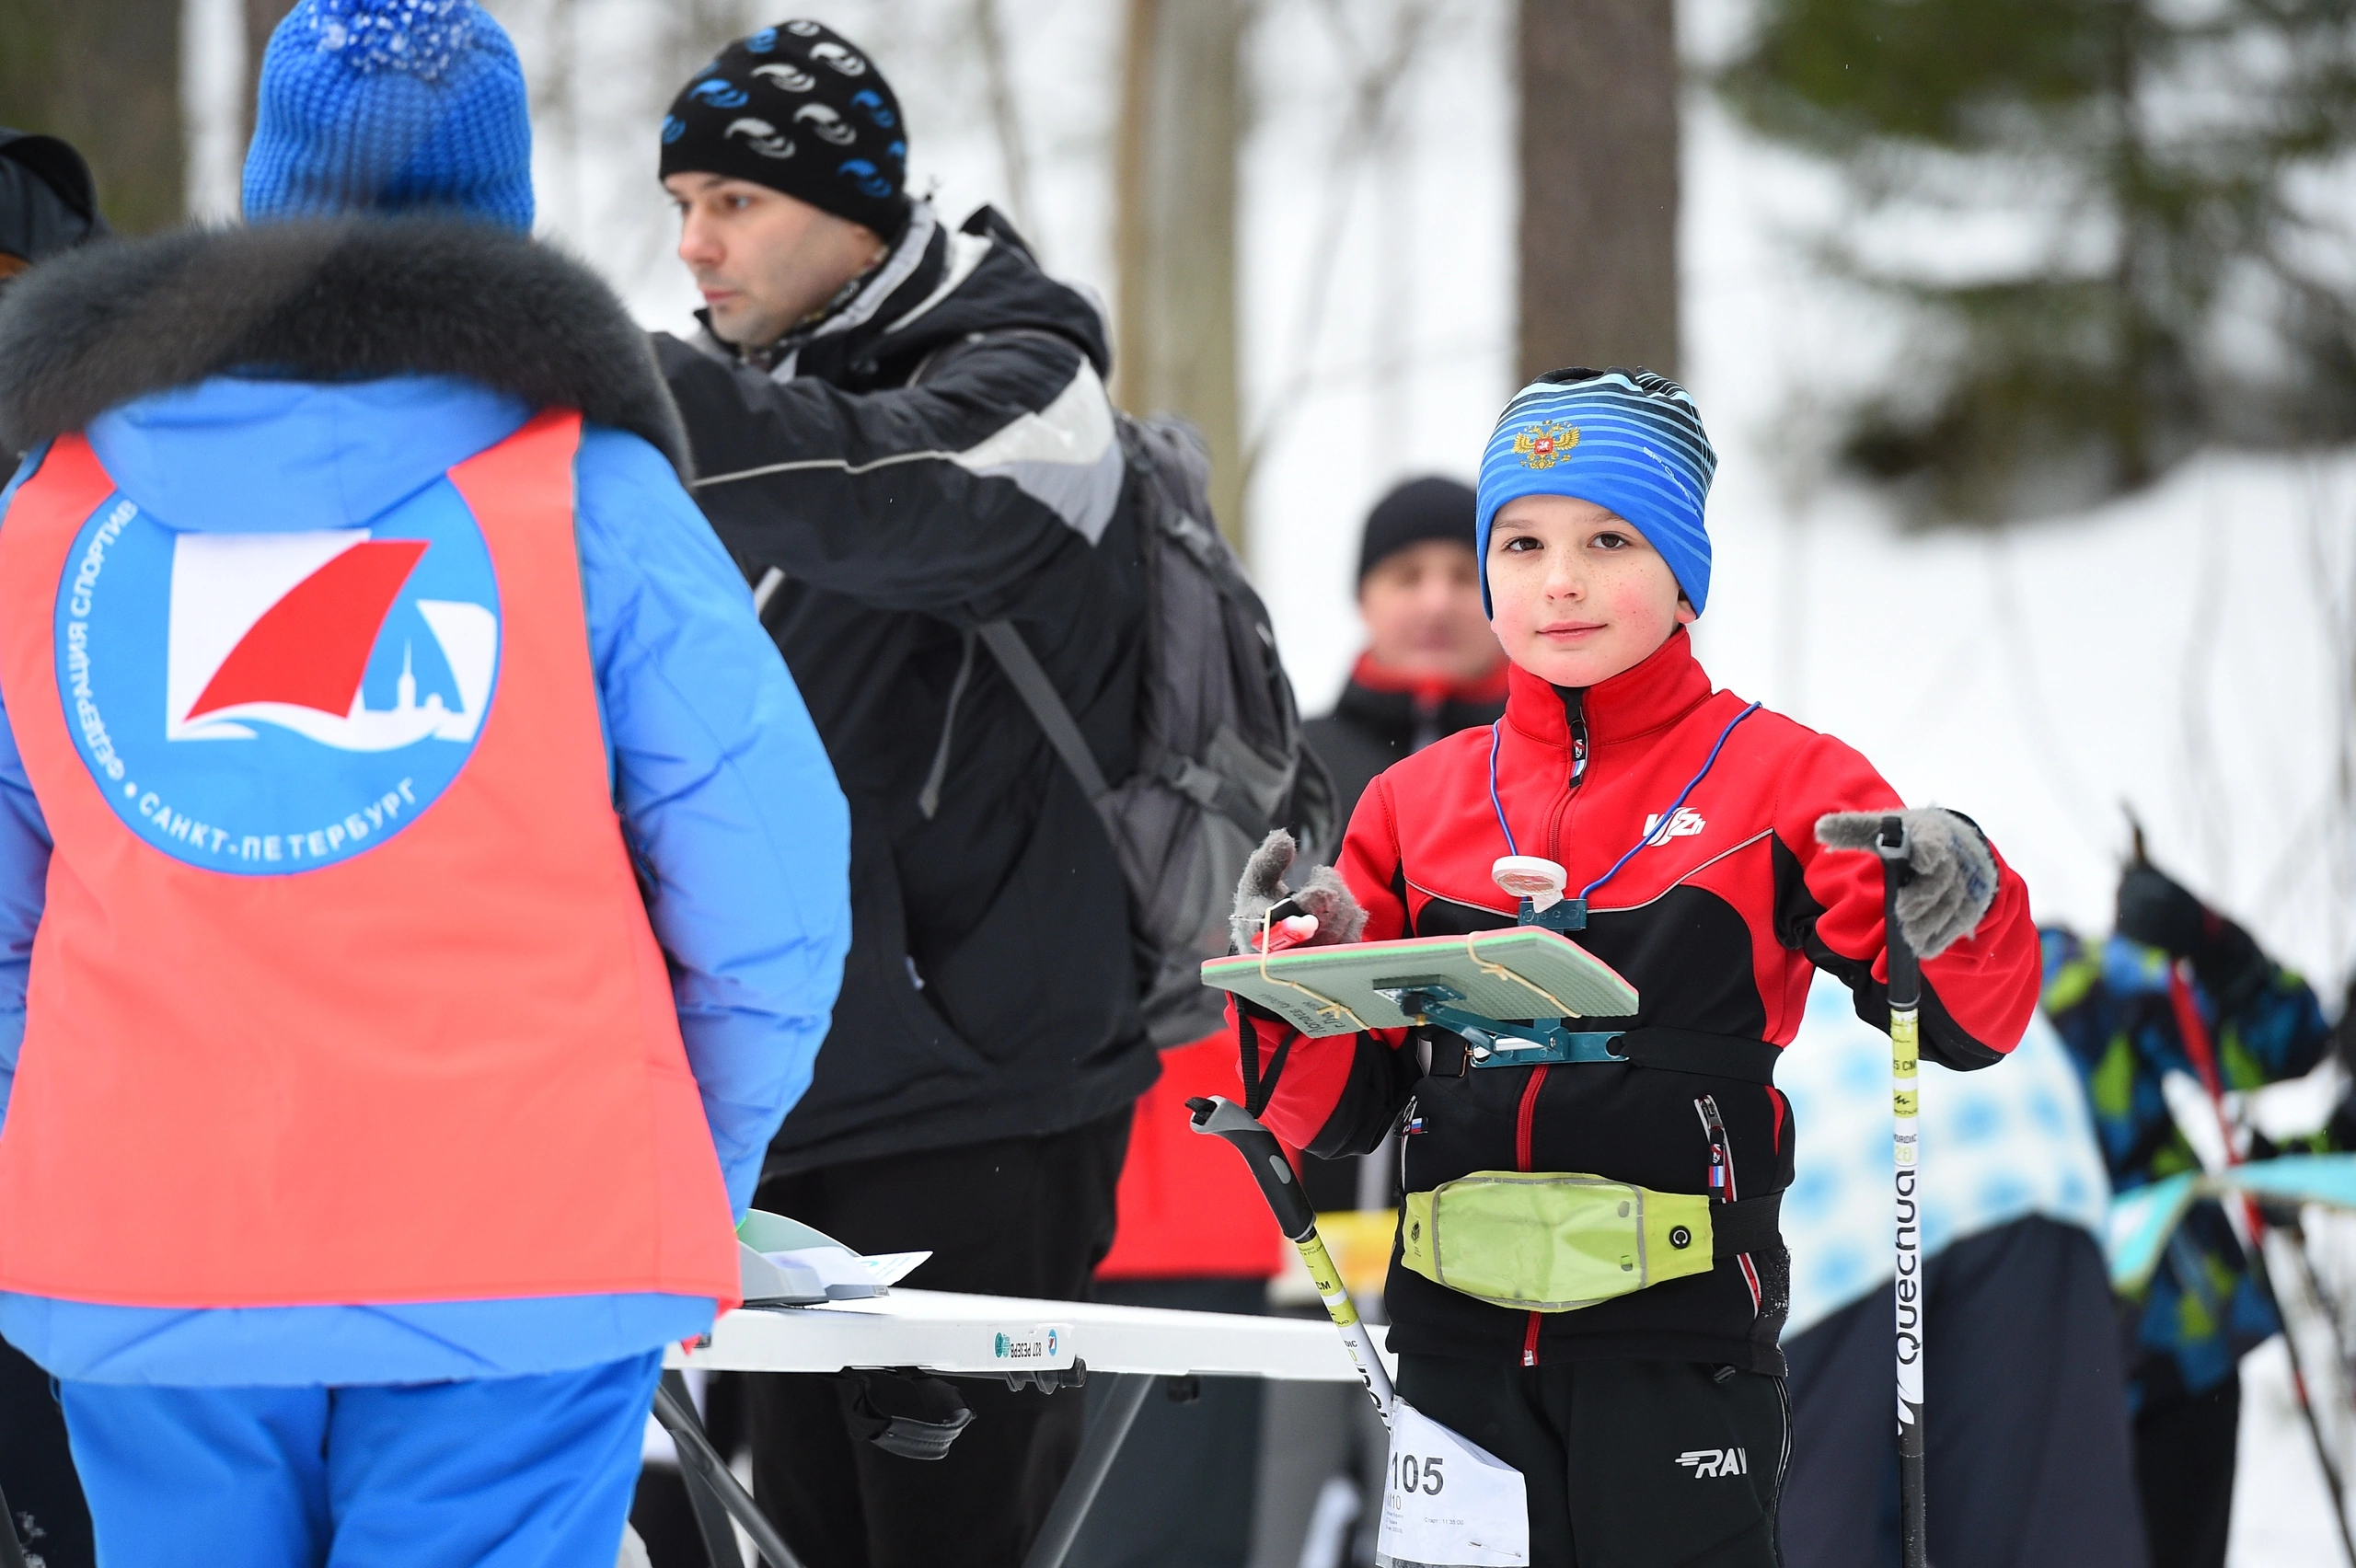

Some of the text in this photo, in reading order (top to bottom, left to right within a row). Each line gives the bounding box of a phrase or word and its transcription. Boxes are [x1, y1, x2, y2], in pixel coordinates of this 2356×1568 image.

[67, 622, 126, 782] ФЕДЕРАЦИЯ
[138, 778, 419, 862] САНКТ-ПЕТЕРБУРГ
[1894, 1170, 1923, 1365] Quechua
[1392, 1451, 1444, 1495] 105
